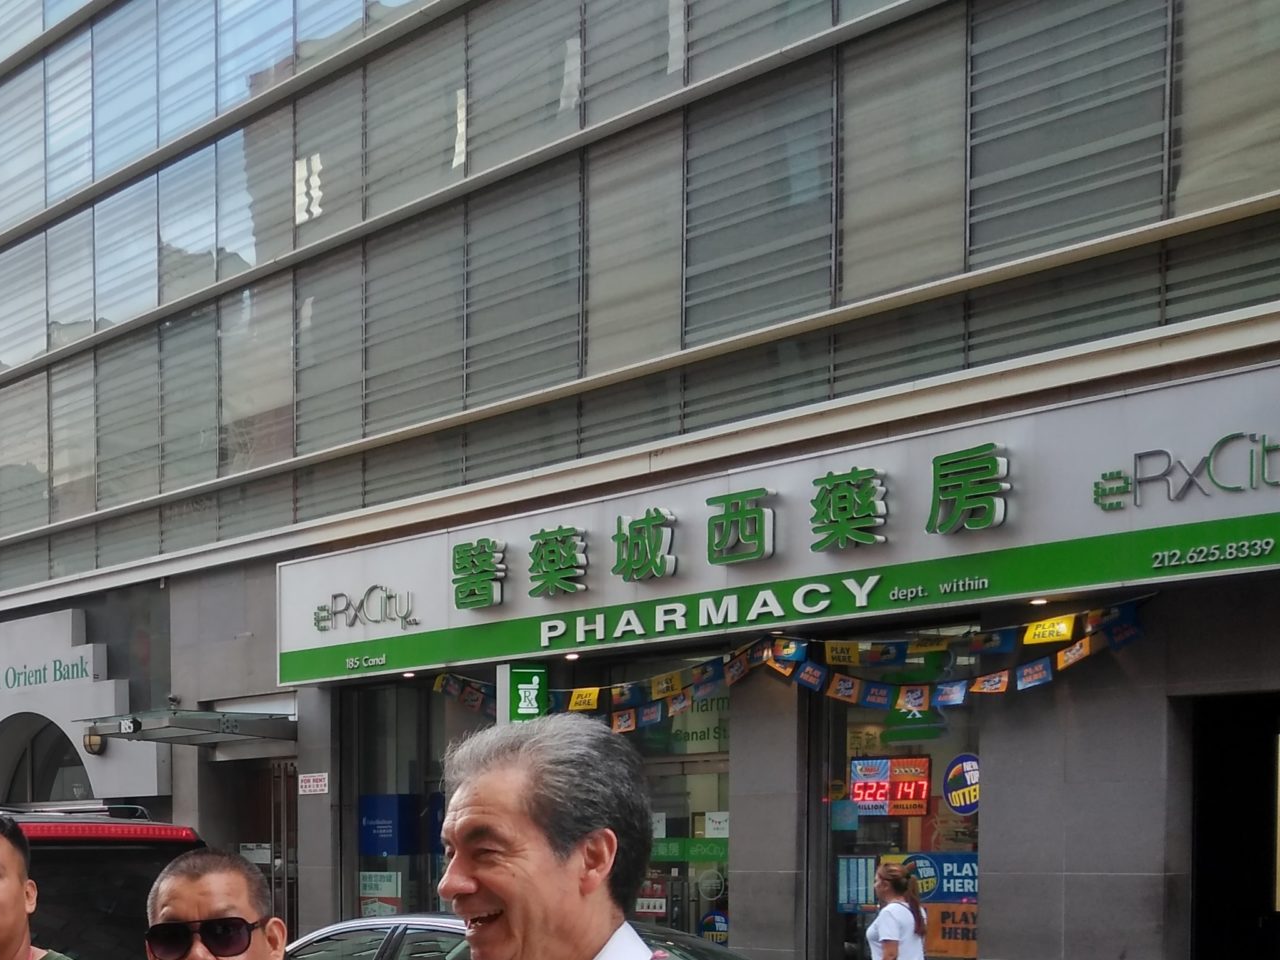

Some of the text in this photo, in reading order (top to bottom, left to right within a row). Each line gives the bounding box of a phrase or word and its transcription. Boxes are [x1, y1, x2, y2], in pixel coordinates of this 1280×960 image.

[452, 442, 1011, 610] 醫藥城西藥房
[1151, 537, 1275, 569] 212.625.8339
[540, 575, 988, 647] PHARMACY dept. within
[1034, 621, 1063, 632] PLAY
[831, 646, 850, 655] PLAY
[345, 653, 386, 669] 185 Canal
[5, 664, 48, 689] Orient
[53, 655, 89, 682] Bank
[675, 728, 710, 742] Canal
[853, 781, 928, 802] 522 147
[948, 784, 980, 808] LOTTE
[893, 803, 924, 811] MILLION
[943, 862, 978, 877] PLAY
[940, 911, 977, 925] PLAY
